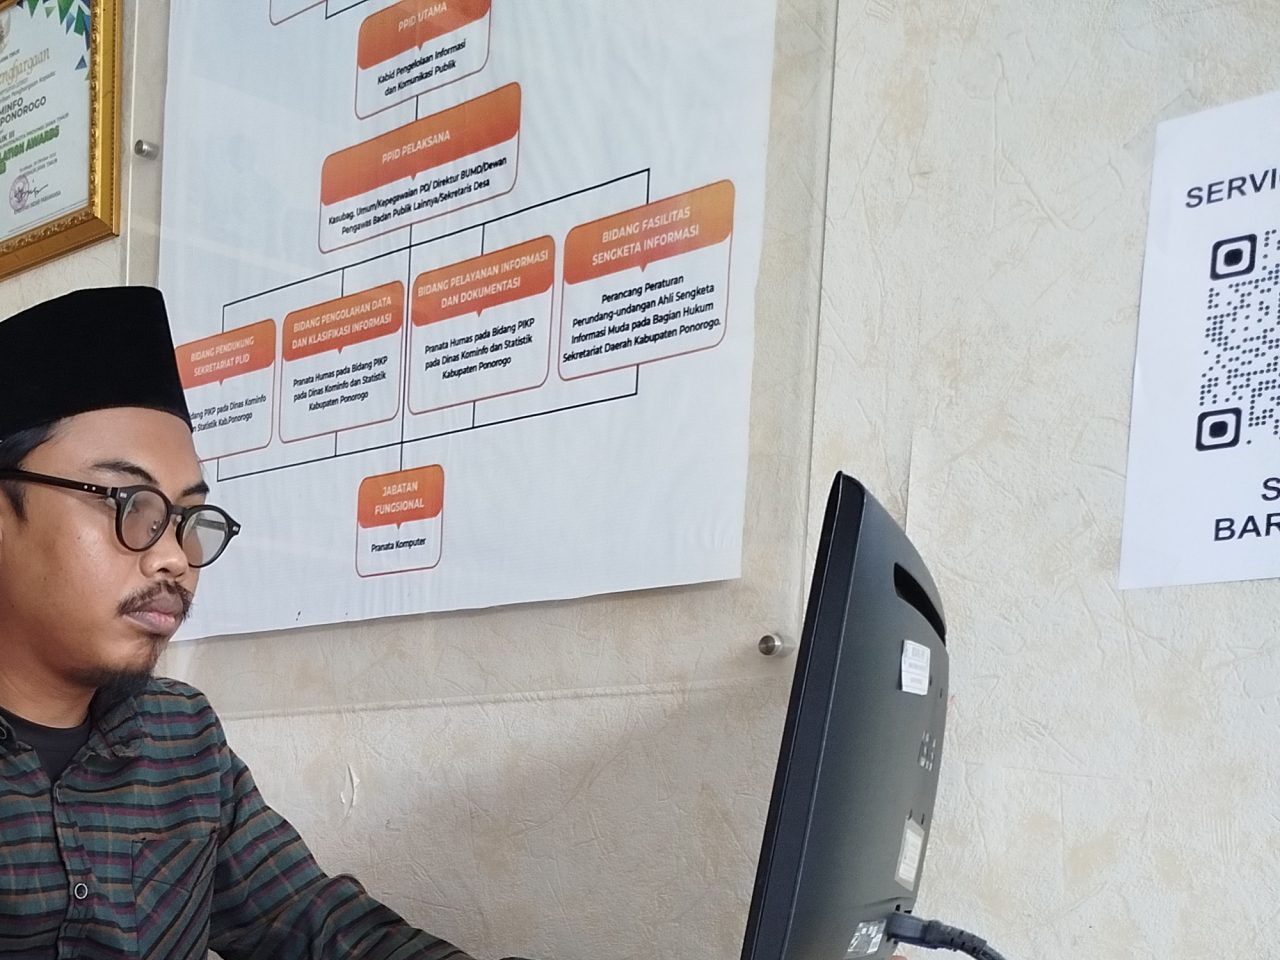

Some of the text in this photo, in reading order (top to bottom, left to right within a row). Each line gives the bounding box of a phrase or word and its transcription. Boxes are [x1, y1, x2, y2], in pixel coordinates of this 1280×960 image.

[398, 2, 447, 32] PPID UTAMA
[377, 71, 395, 85] Kabid
[435, 39, 466, 59] Informasi
[385, 60, 456, 96] dan Komunikasi Publik
[0, 96, 46, 126] PONOROGO
[382, 131, 451, 163] PPID PELAKSANA
[433, 174, 459, 188] Direktur
[1185, 168, 1280, 208] SERVI
[342, 219, 371, 235] Pengawas
[373, 213, 391, 225] Badan
[393, 204, 412, 217] Publik
[474, 178, 490, 191] Desa
[602, 206, 690, 243] BIDANG FASILITAS
[592, 224, 699, 266] SENGKETA INFORMASI
[418, 250, 548, 297] BIDANG PELAYANAN INFORMASI
[602, 275, 684, 304] Perancang Peraturan
[441, 276, 520, 308] DAN DOKUMENTASI
[572, 284, 714, 328] Perundang-undangan Ahli Sengketa
[292, 313, 391, 349] DAN KLASIFIKASI INFORMASI
[294, 296, 391, 333] BIDANG PENGOLAHAN DATA
[572, 302, 713, 344] Informasi Muda pada Bagian Hukum
[425, 318, 535, 354] Pranata Humas pada Bidang PIKP
[425, 334, 533, 371] pada Dinas Kominfo dan Statistik
[563, 345, 603, 362] Sekretariat
[605, 338, 632, 352] Daerah
[634, 328, 677, 345] Kabupaten
[293, 377, 314, 387] Pranata
[315, 371, 334, 381] Humas
[336, 366, 350, 378] pada
[352, 361, 372, 372] Bidang
[442, 357, 511, 379] Kabupaten Ponorogo
[293, 371, 386, 402] pada Dinas Kominfo dan Statistik
[309, 391, 368, 411] Kabupaten Ponorogo
[230, 401, 243, 410] Dinas
[382, 481, 418, 496] JABATAN
[375, 498, 424, 515] FUNGSIONAL
[371, 538, 426, 552] Pranata Komputer
